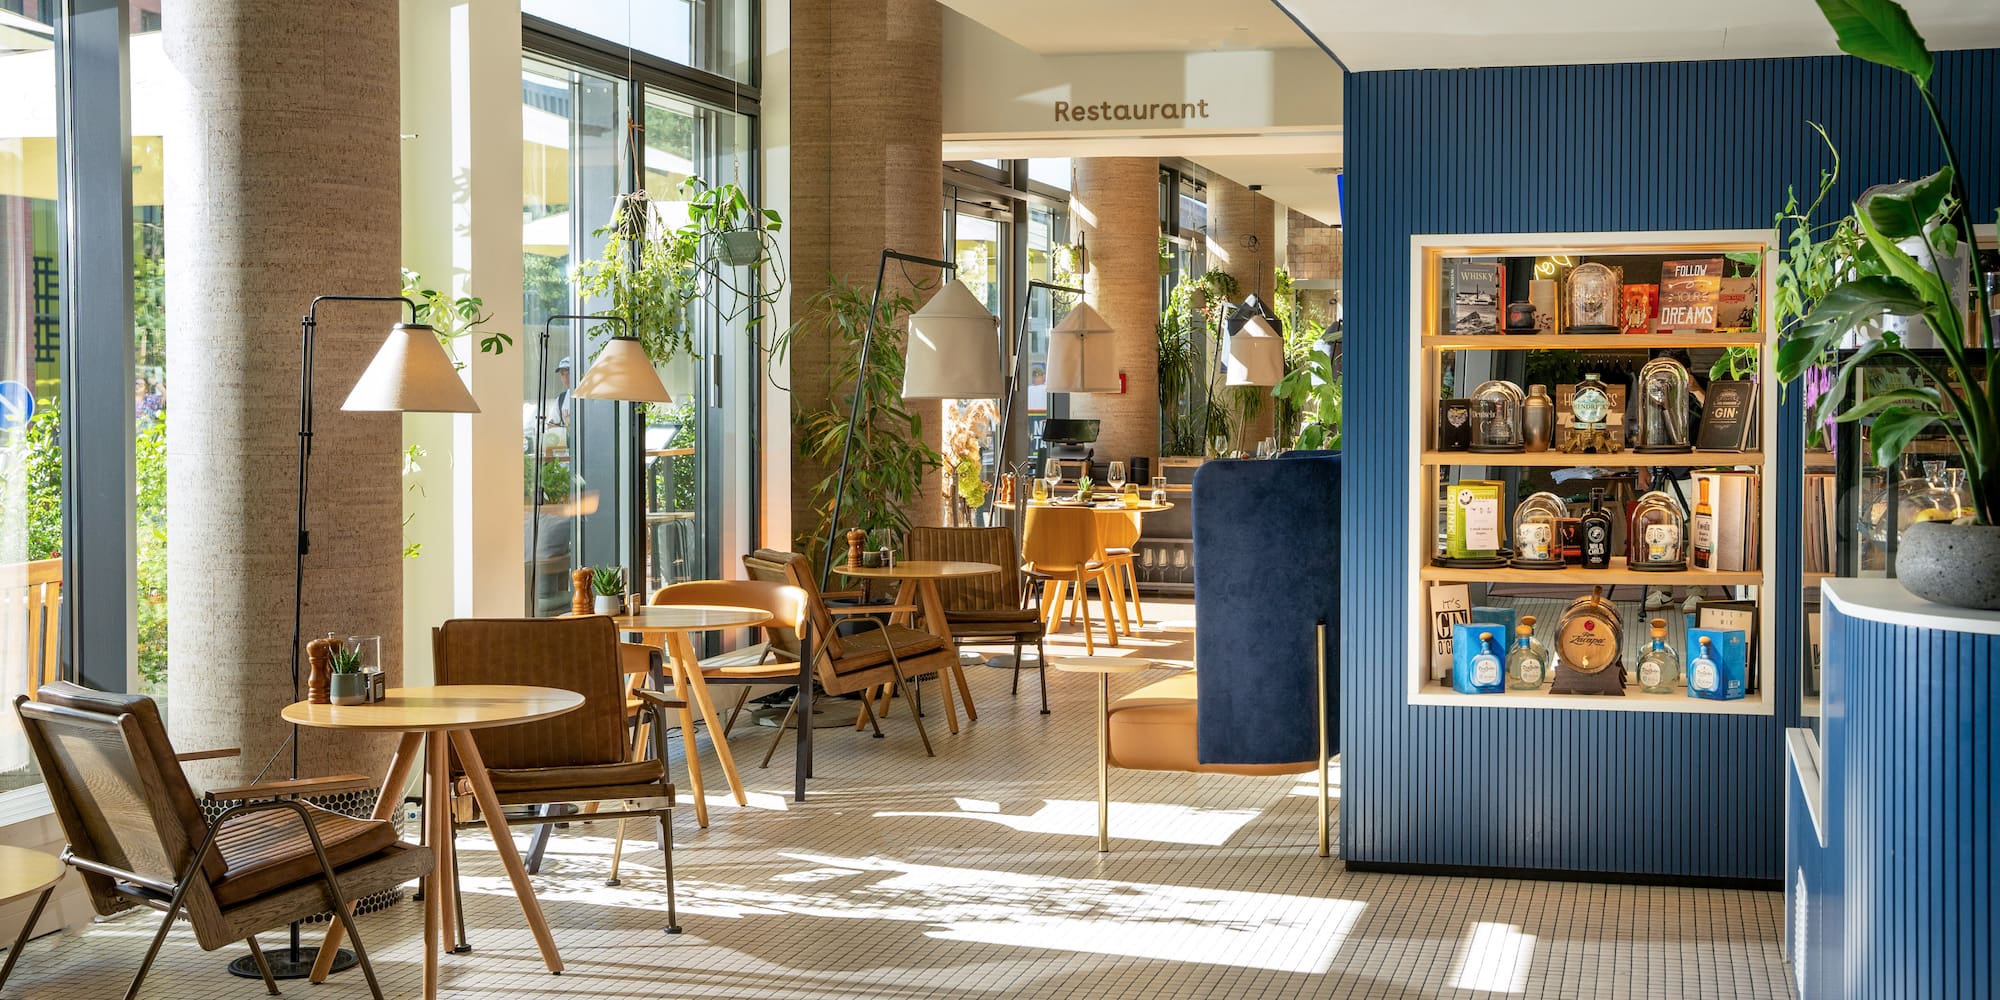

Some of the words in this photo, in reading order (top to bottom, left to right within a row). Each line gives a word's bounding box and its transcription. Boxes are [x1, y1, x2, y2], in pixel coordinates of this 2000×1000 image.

[1054, 99, 1209, 122] Restaurant
[1461, 271, 1493, 281] WHISKY
[1675, 264, 1707, 277] FOLLOW
[1661, 306, 1713, 325] DREAMS
[1715, 408, 1736, 418] GIN
[1442, 598, 1462, 609] IT'S
